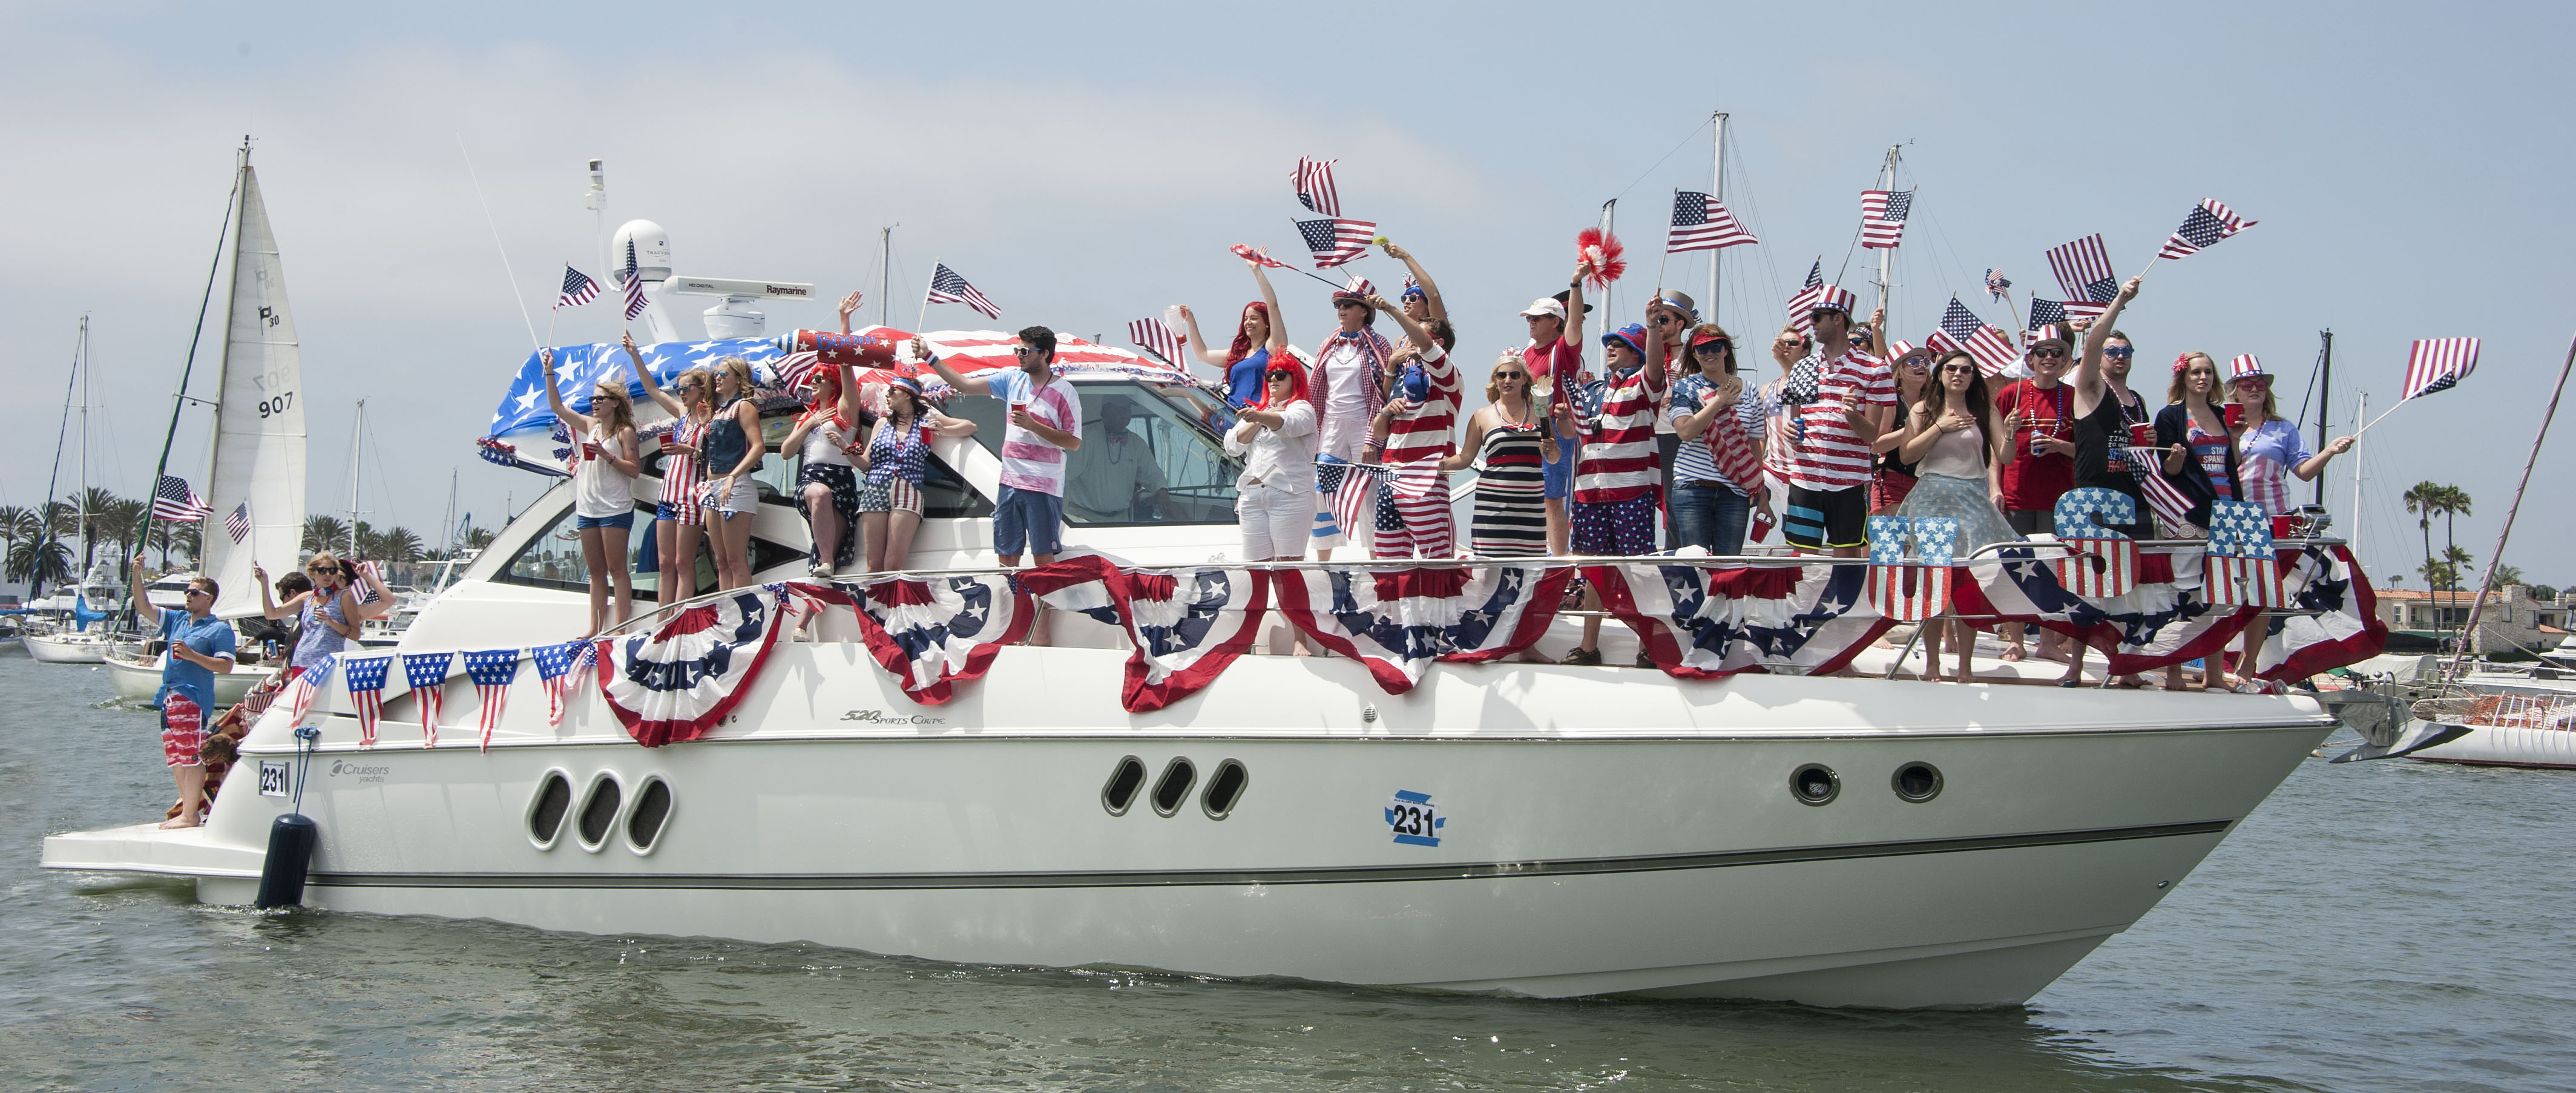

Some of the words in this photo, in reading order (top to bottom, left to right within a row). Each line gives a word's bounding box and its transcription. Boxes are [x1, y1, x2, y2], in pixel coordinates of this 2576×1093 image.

[766, 285, 807, 295] Raymarine
[269, 315, 280, 327] 30
[817, 333, 876, 350] Boom
[258, 391, 293, 419] 907
[840, 710, 882, 721] 520
[343, 763, 389, 775] Cruisers
[263, 767, 284, 792] 231
[358, 775, 384, 784] yachts
[1393, 804, 1433, 837] 231
